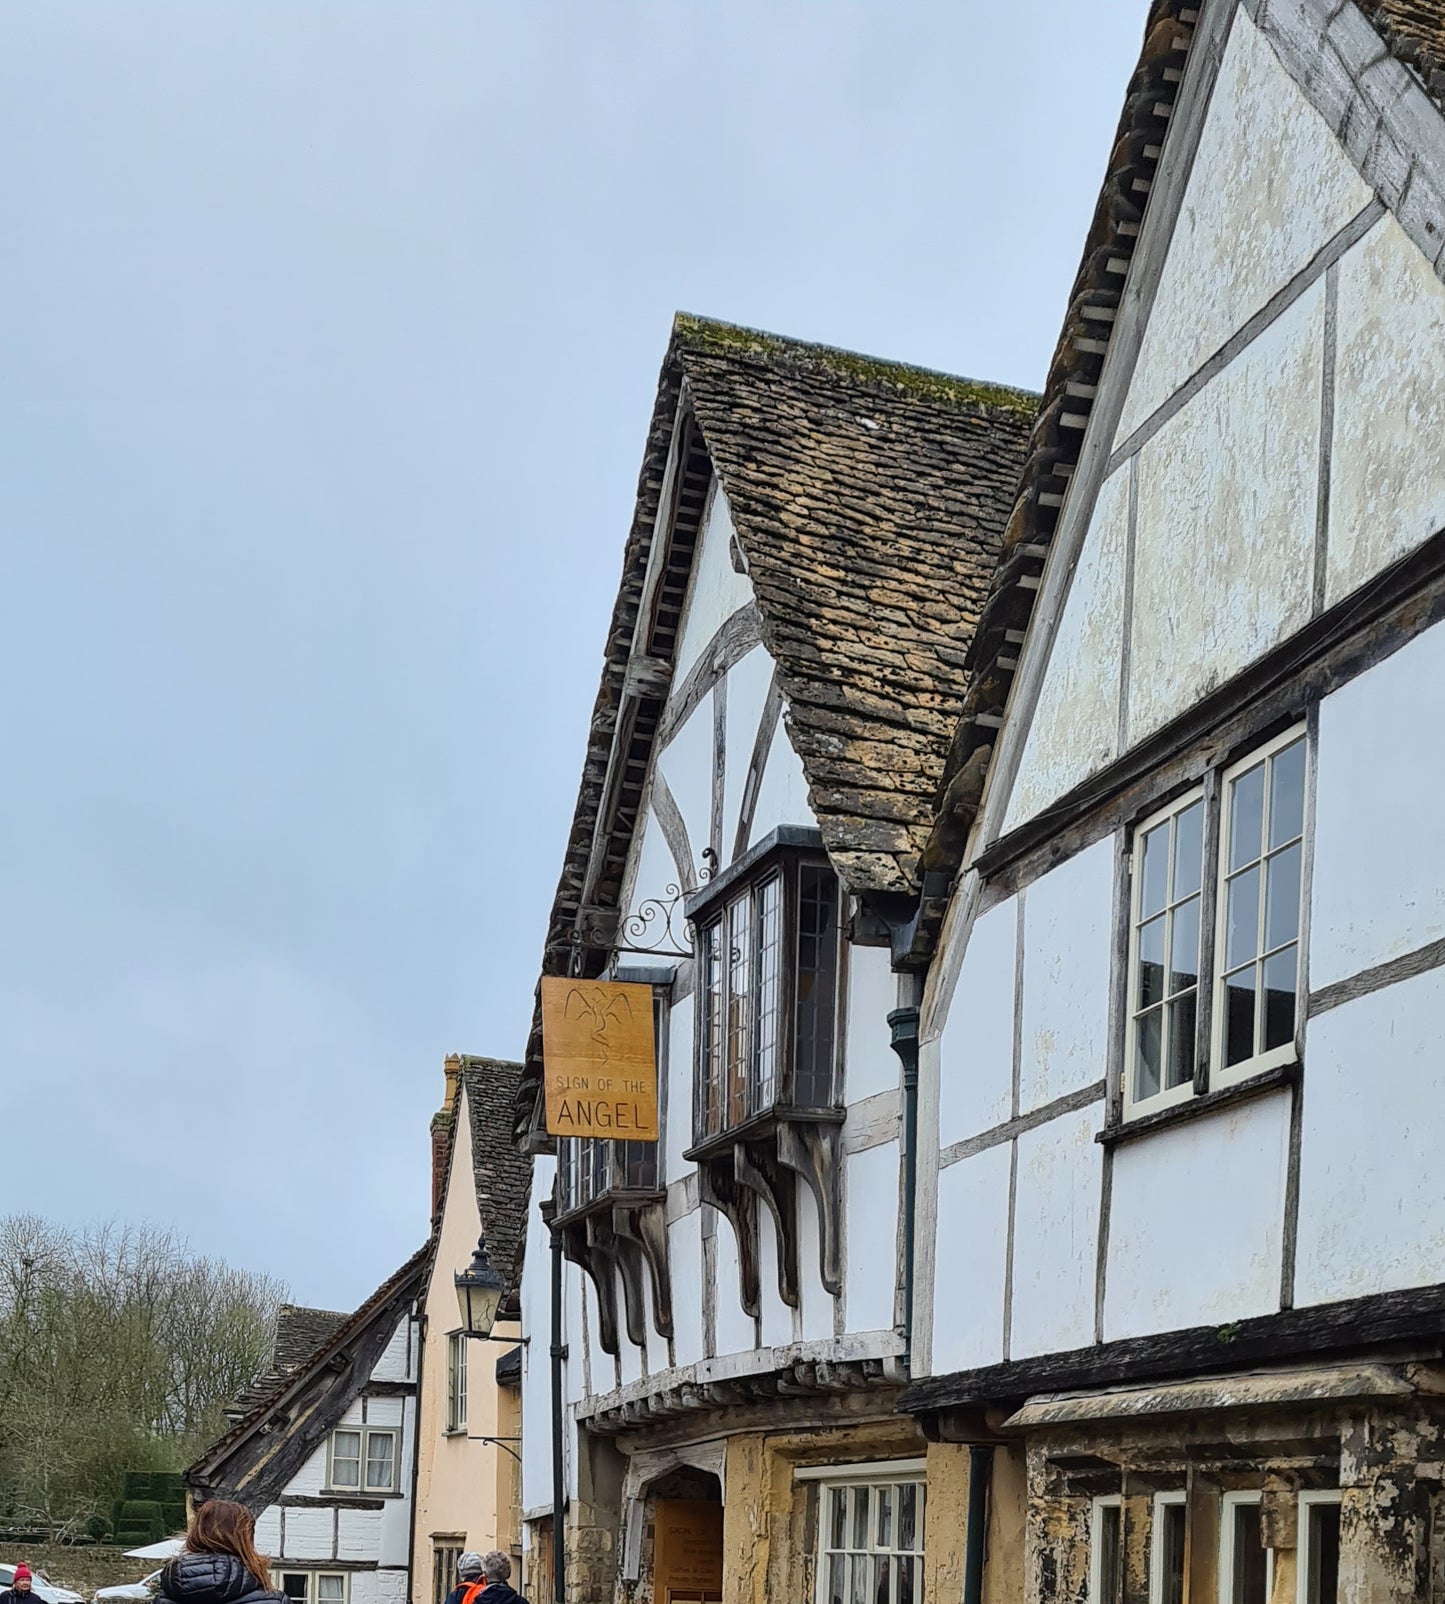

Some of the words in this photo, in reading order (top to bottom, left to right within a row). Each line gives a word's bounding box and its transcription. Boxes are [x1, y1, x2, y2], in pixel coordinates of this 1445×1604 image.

[556, 1076, 589, 1089] SIGN
[597, 1078, 613, 1091] OF
[624, 1080, 646, 1094] THE
[557, 1099, 649, 1130] ANGEL
